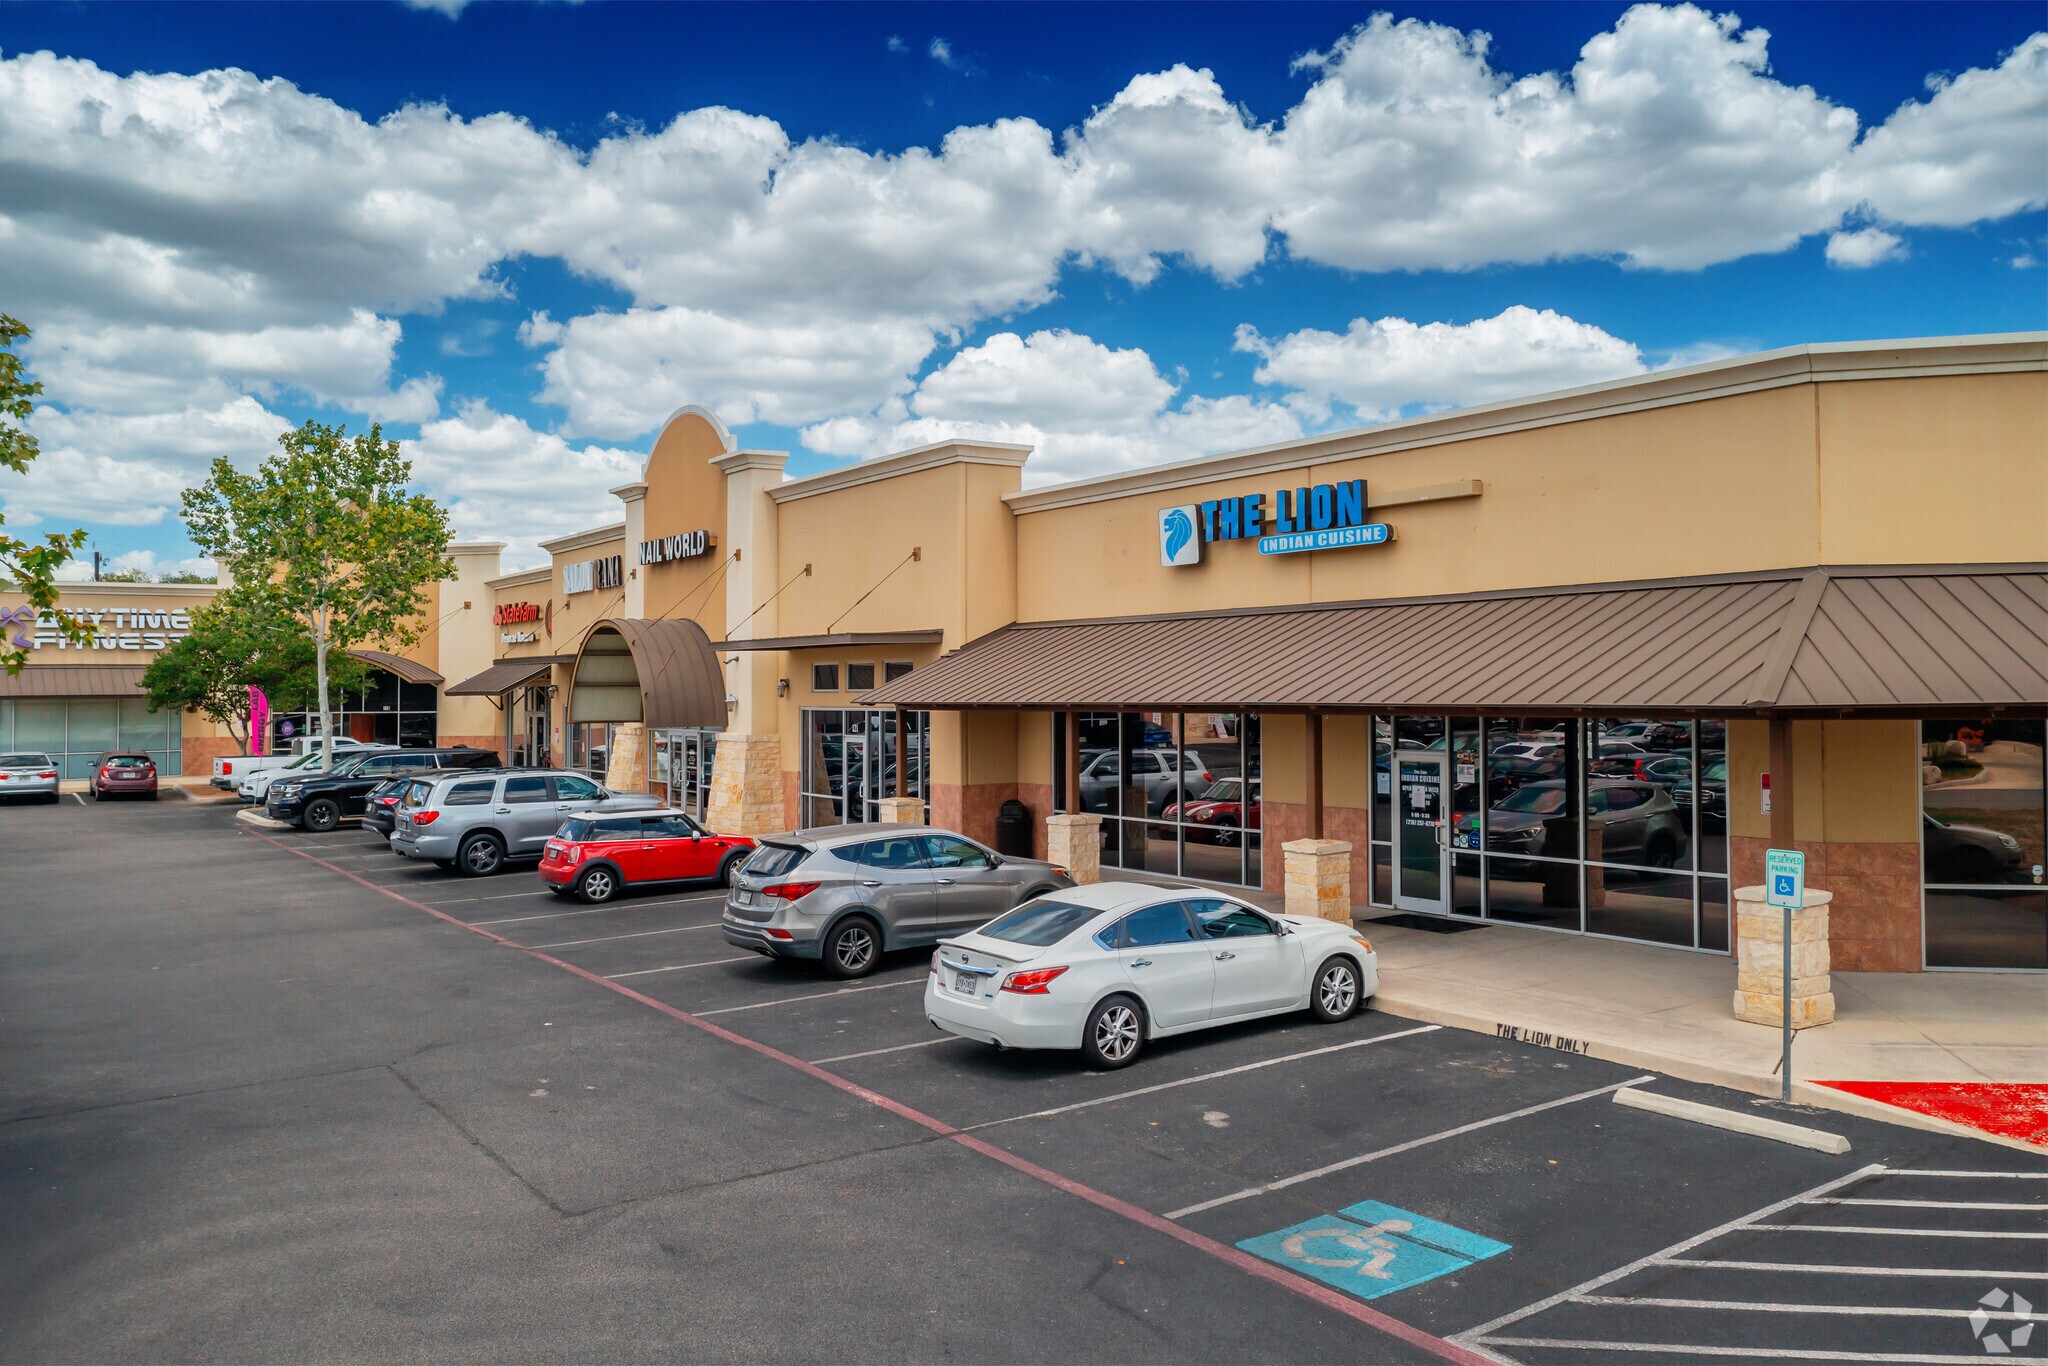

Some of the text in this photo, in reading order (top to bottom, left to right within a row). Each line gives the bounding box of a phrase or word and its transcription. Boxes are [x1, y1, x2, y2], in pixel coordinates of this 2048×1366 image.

[1202, 479, 1366, 542] THE LION
[639, 530, 706, 565] NAIL WORLD
[1263, 527, 1382, 552] INDIAN CUISINE
[1769, 855, 1802, 865] RESERVED
[1771, 865, 1799, 874] PARKING
[1497, 1023, 1590, 1054] THE LION ONLY
